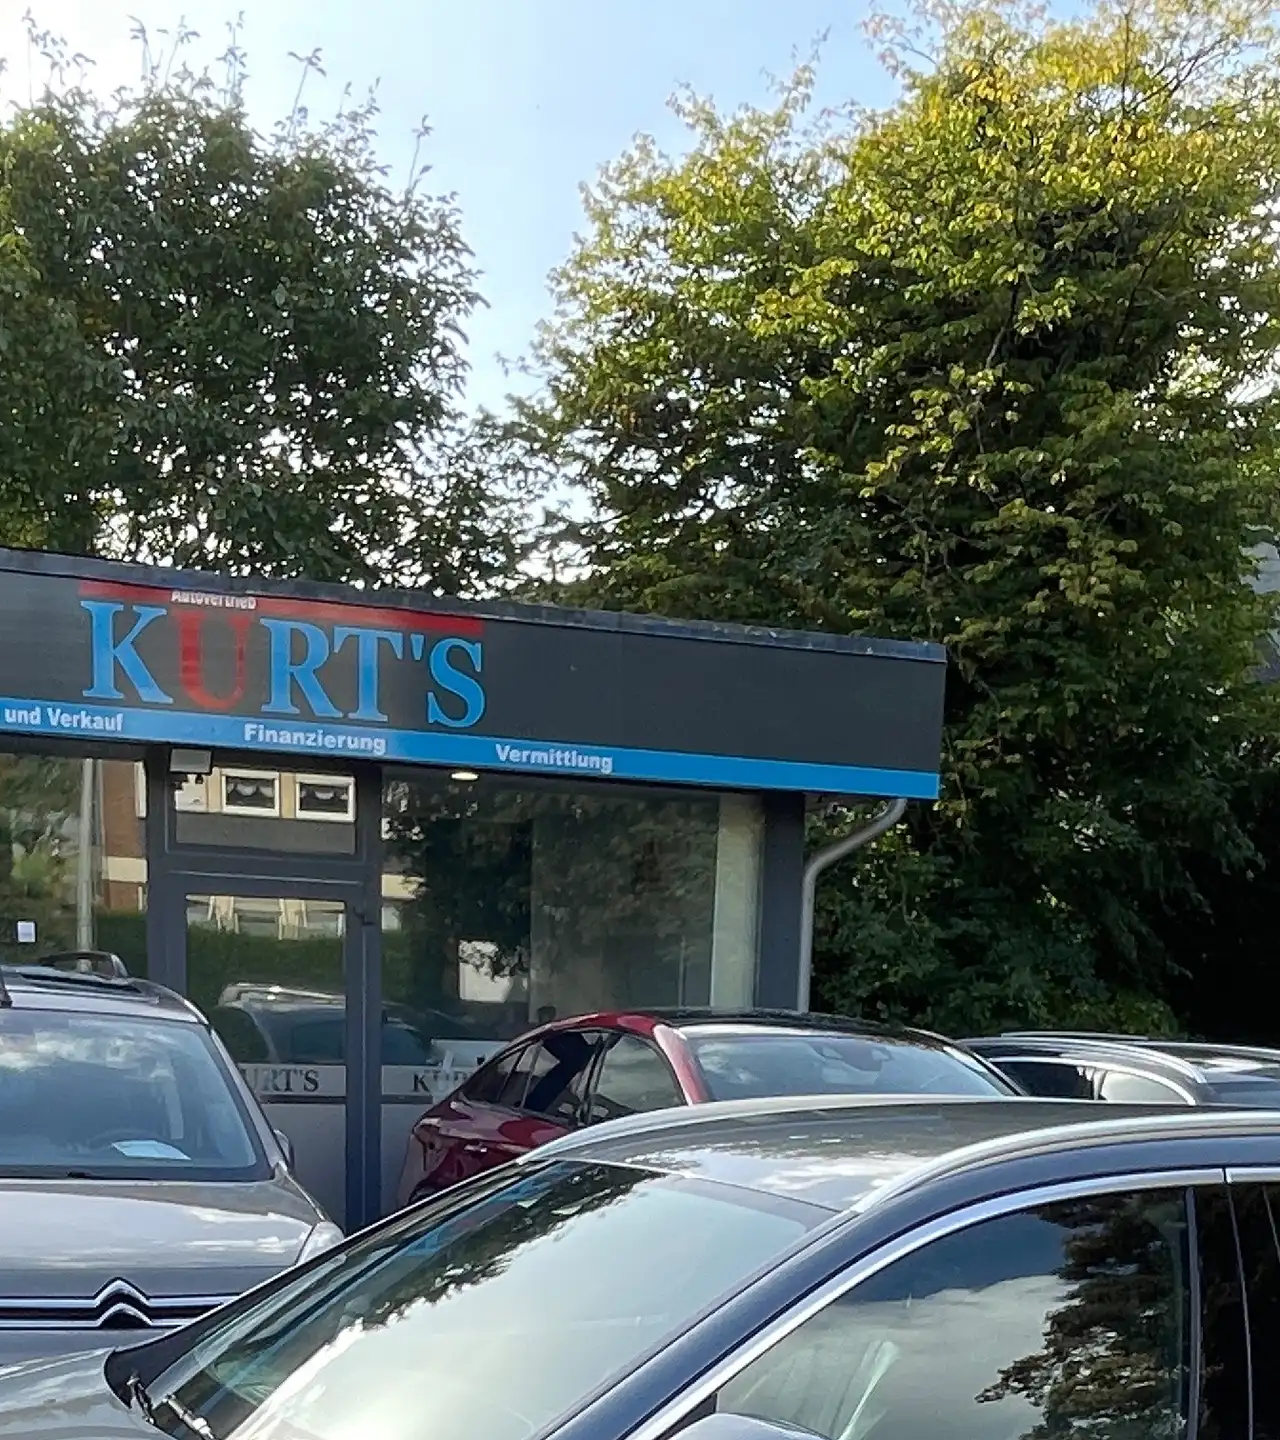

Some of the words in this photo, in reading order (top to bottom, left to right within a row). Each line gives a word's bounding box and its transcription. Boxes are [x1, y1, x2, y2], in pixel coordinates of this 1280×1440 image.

[80, 600, 487, 728] KURT'S
[4, 707, 41, 726] und
[46, 707, 124, 732] Verkauf
[244, 722, 387, 756] Finanzierung
[495, 743, 614, 775] Vermittlung
[239, 1068, 320, 1092] URT'S
